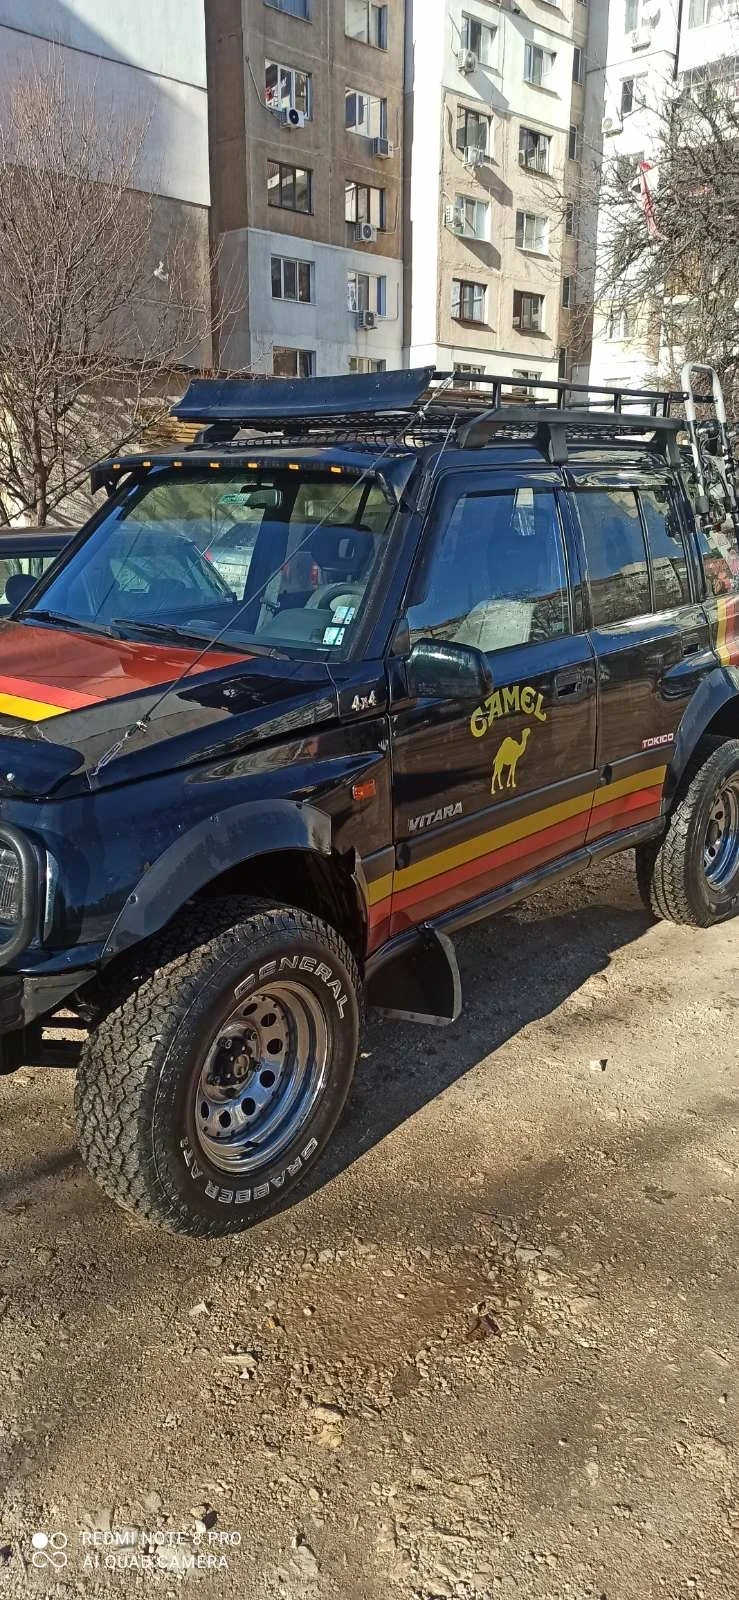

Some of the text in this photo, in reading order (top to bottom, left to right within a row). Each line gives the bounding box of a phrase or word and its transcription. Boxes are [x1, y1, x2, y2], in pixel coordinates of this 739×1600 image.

[352, 690, 377, 711] 4x4
[470, 686, 547, 737] CAMEL
[642, 733, 674, 748] TOKICO
[408, 801, 463, 832] VITARA
[234, 955, 349, 1019] GENERAL
[204, 1137, 319, 1204] GRABBER
